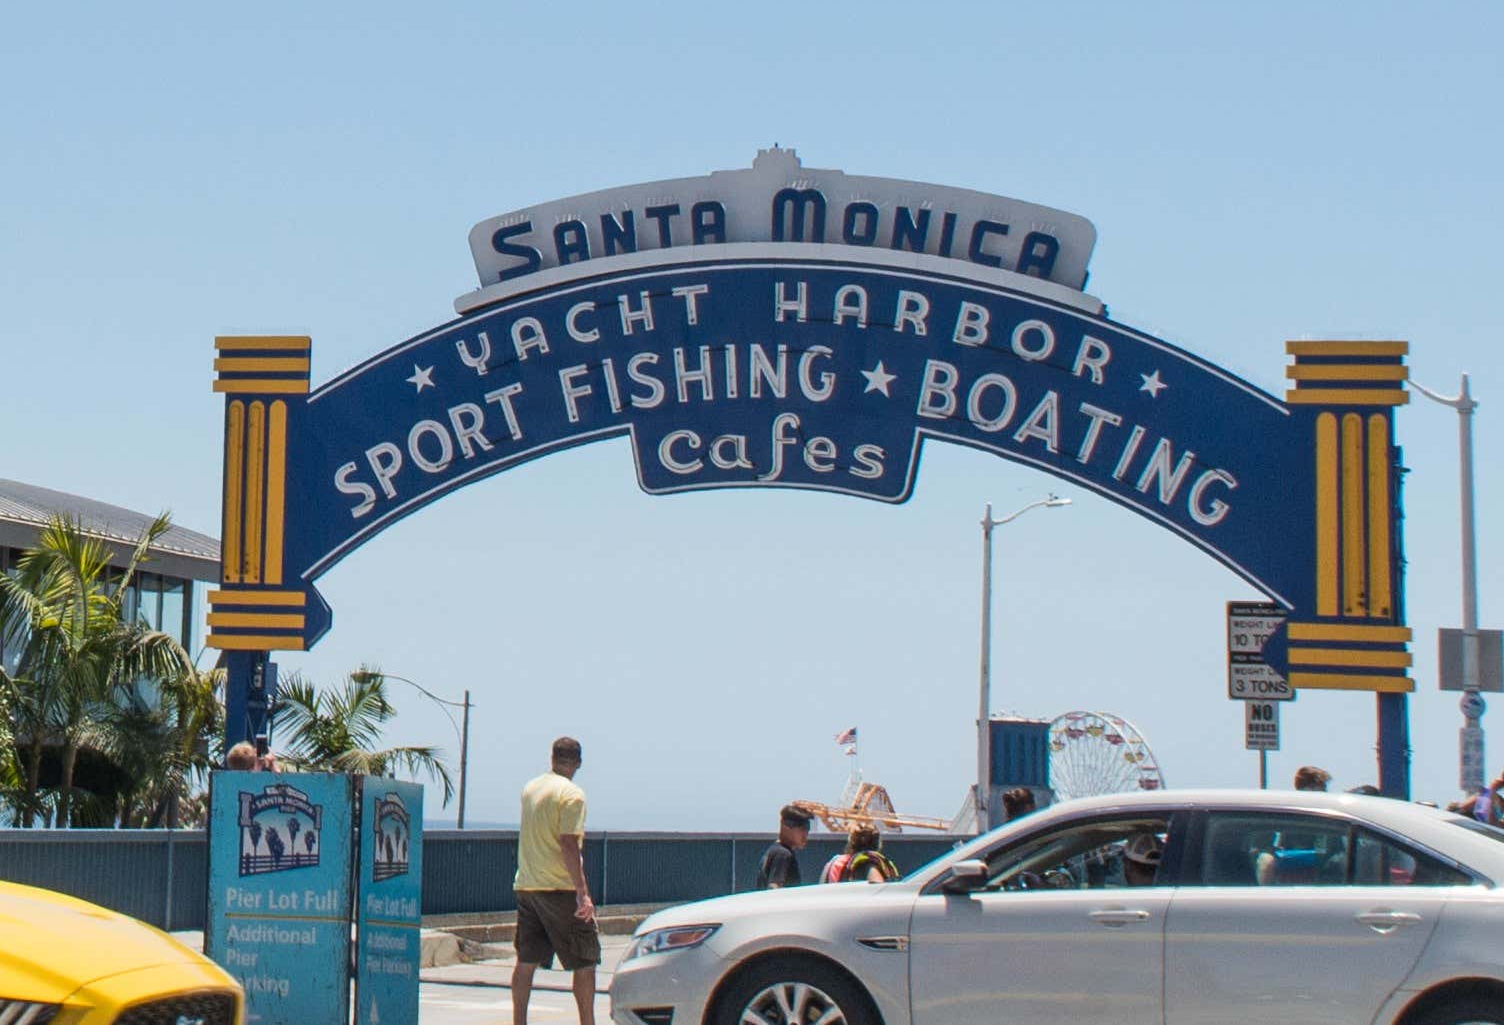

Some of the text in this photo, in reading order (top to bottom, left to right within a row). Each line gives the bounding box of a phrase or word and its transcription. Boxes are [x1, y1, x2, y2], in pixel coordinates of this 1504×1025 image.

[492, 187, 1061, 284] SANTA MONICA
[455, 280, 1113, 385] YACHT HARBOR
[333, 343, 1239, 527] SPORT FISHING BOATING
[1233, 633, 1270, 647] 10 TO
[1235, 678, 1289, 693] 3 TONS
[1251, 704, 1273, 721] NO
[226, 887, 339, 911] Pier Lot Full
[226, 924, 317, 946] Additional
[225, 948, 258, 967] Pier
